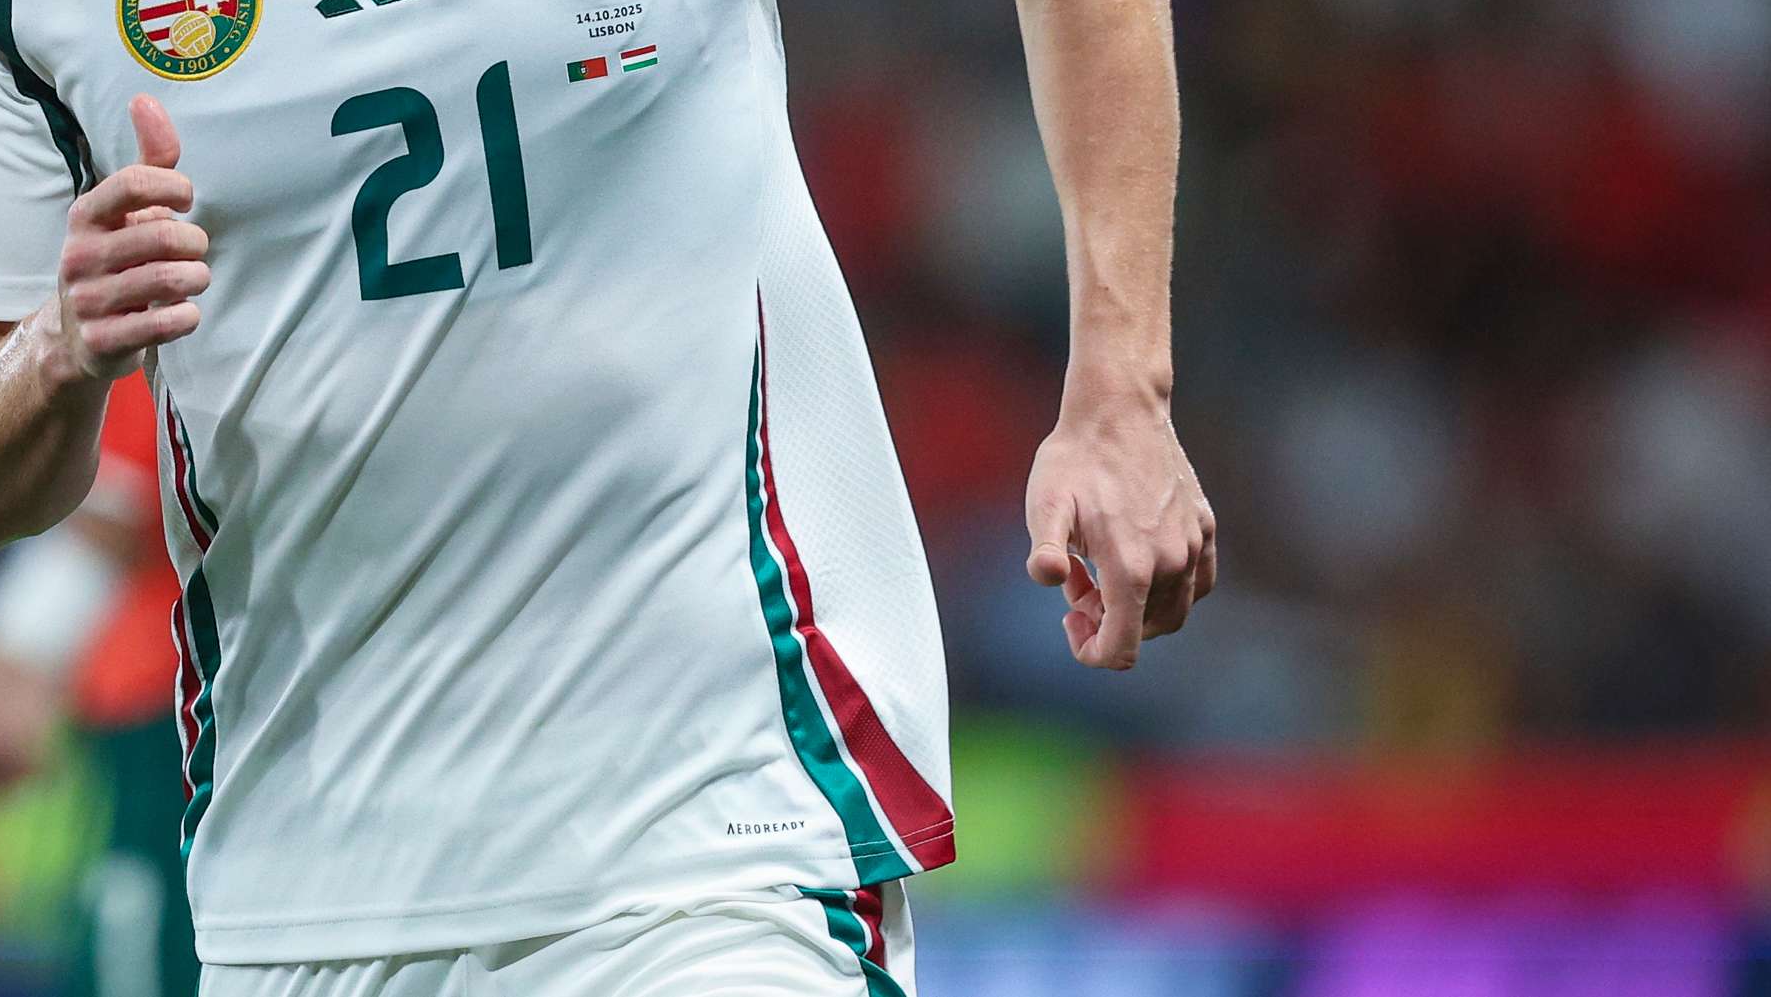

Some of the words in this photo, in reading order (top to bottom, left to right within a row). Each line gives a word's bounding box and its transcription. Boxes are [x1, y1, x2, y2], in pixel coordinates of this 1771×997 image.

[576, 3, 643, 25] 14.10.2025
[588, 21, 635, 39] LISBON
[178, 54, 218, 74] 1901
[331, 60, 533, 301] 21
[727, 820, 805, 836] AEROREADY
